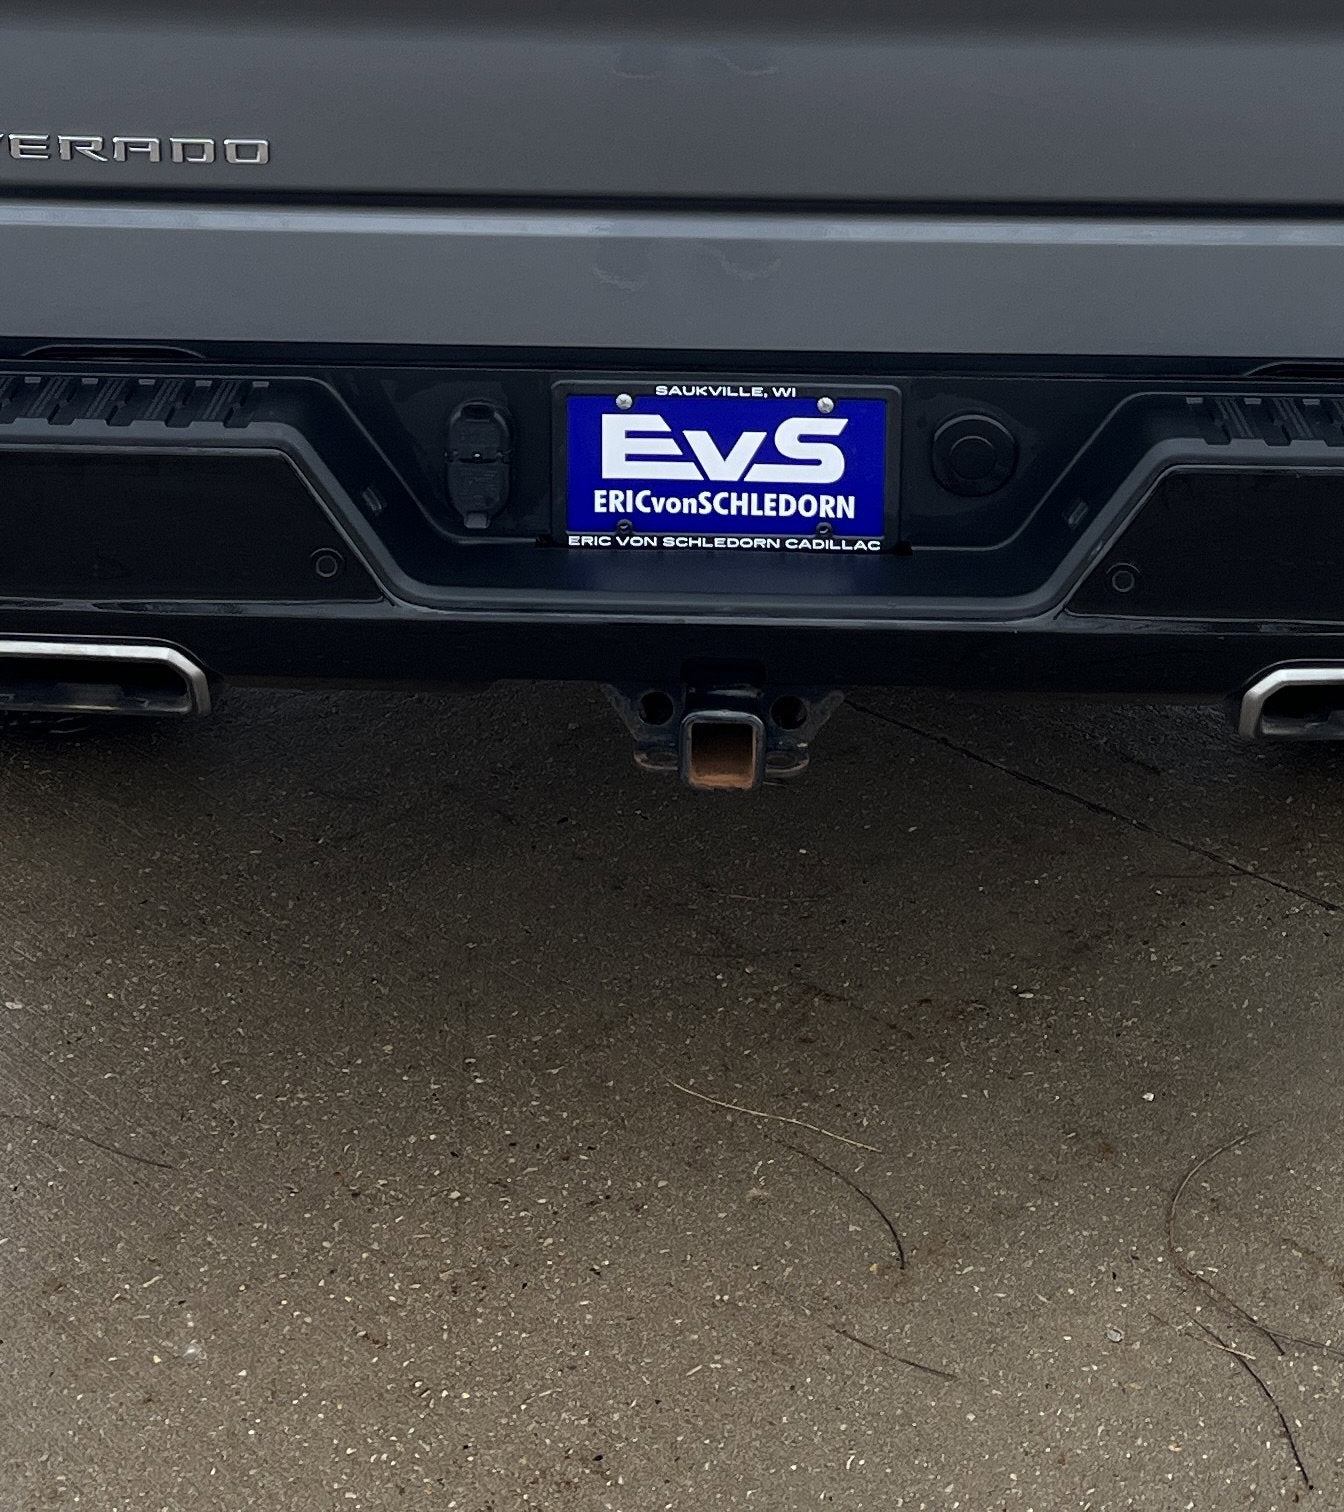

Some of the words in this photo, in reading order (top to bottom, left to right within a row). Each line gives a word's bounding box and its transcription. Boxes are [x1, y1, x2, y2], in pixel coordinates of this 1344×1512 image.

[655, 385, 768, 399] SAUKVILLE,
[772, 387, 796, 399] WI
[593, 489, 856, 520] ERICvonSCHLEDORN
[568, 535, 612, 547] ERIC
[615, 536, 658, 548] VON
[662, 537, 781, 550] SCHLEDORN
[784, 538, 882, 552] CADILLAC
